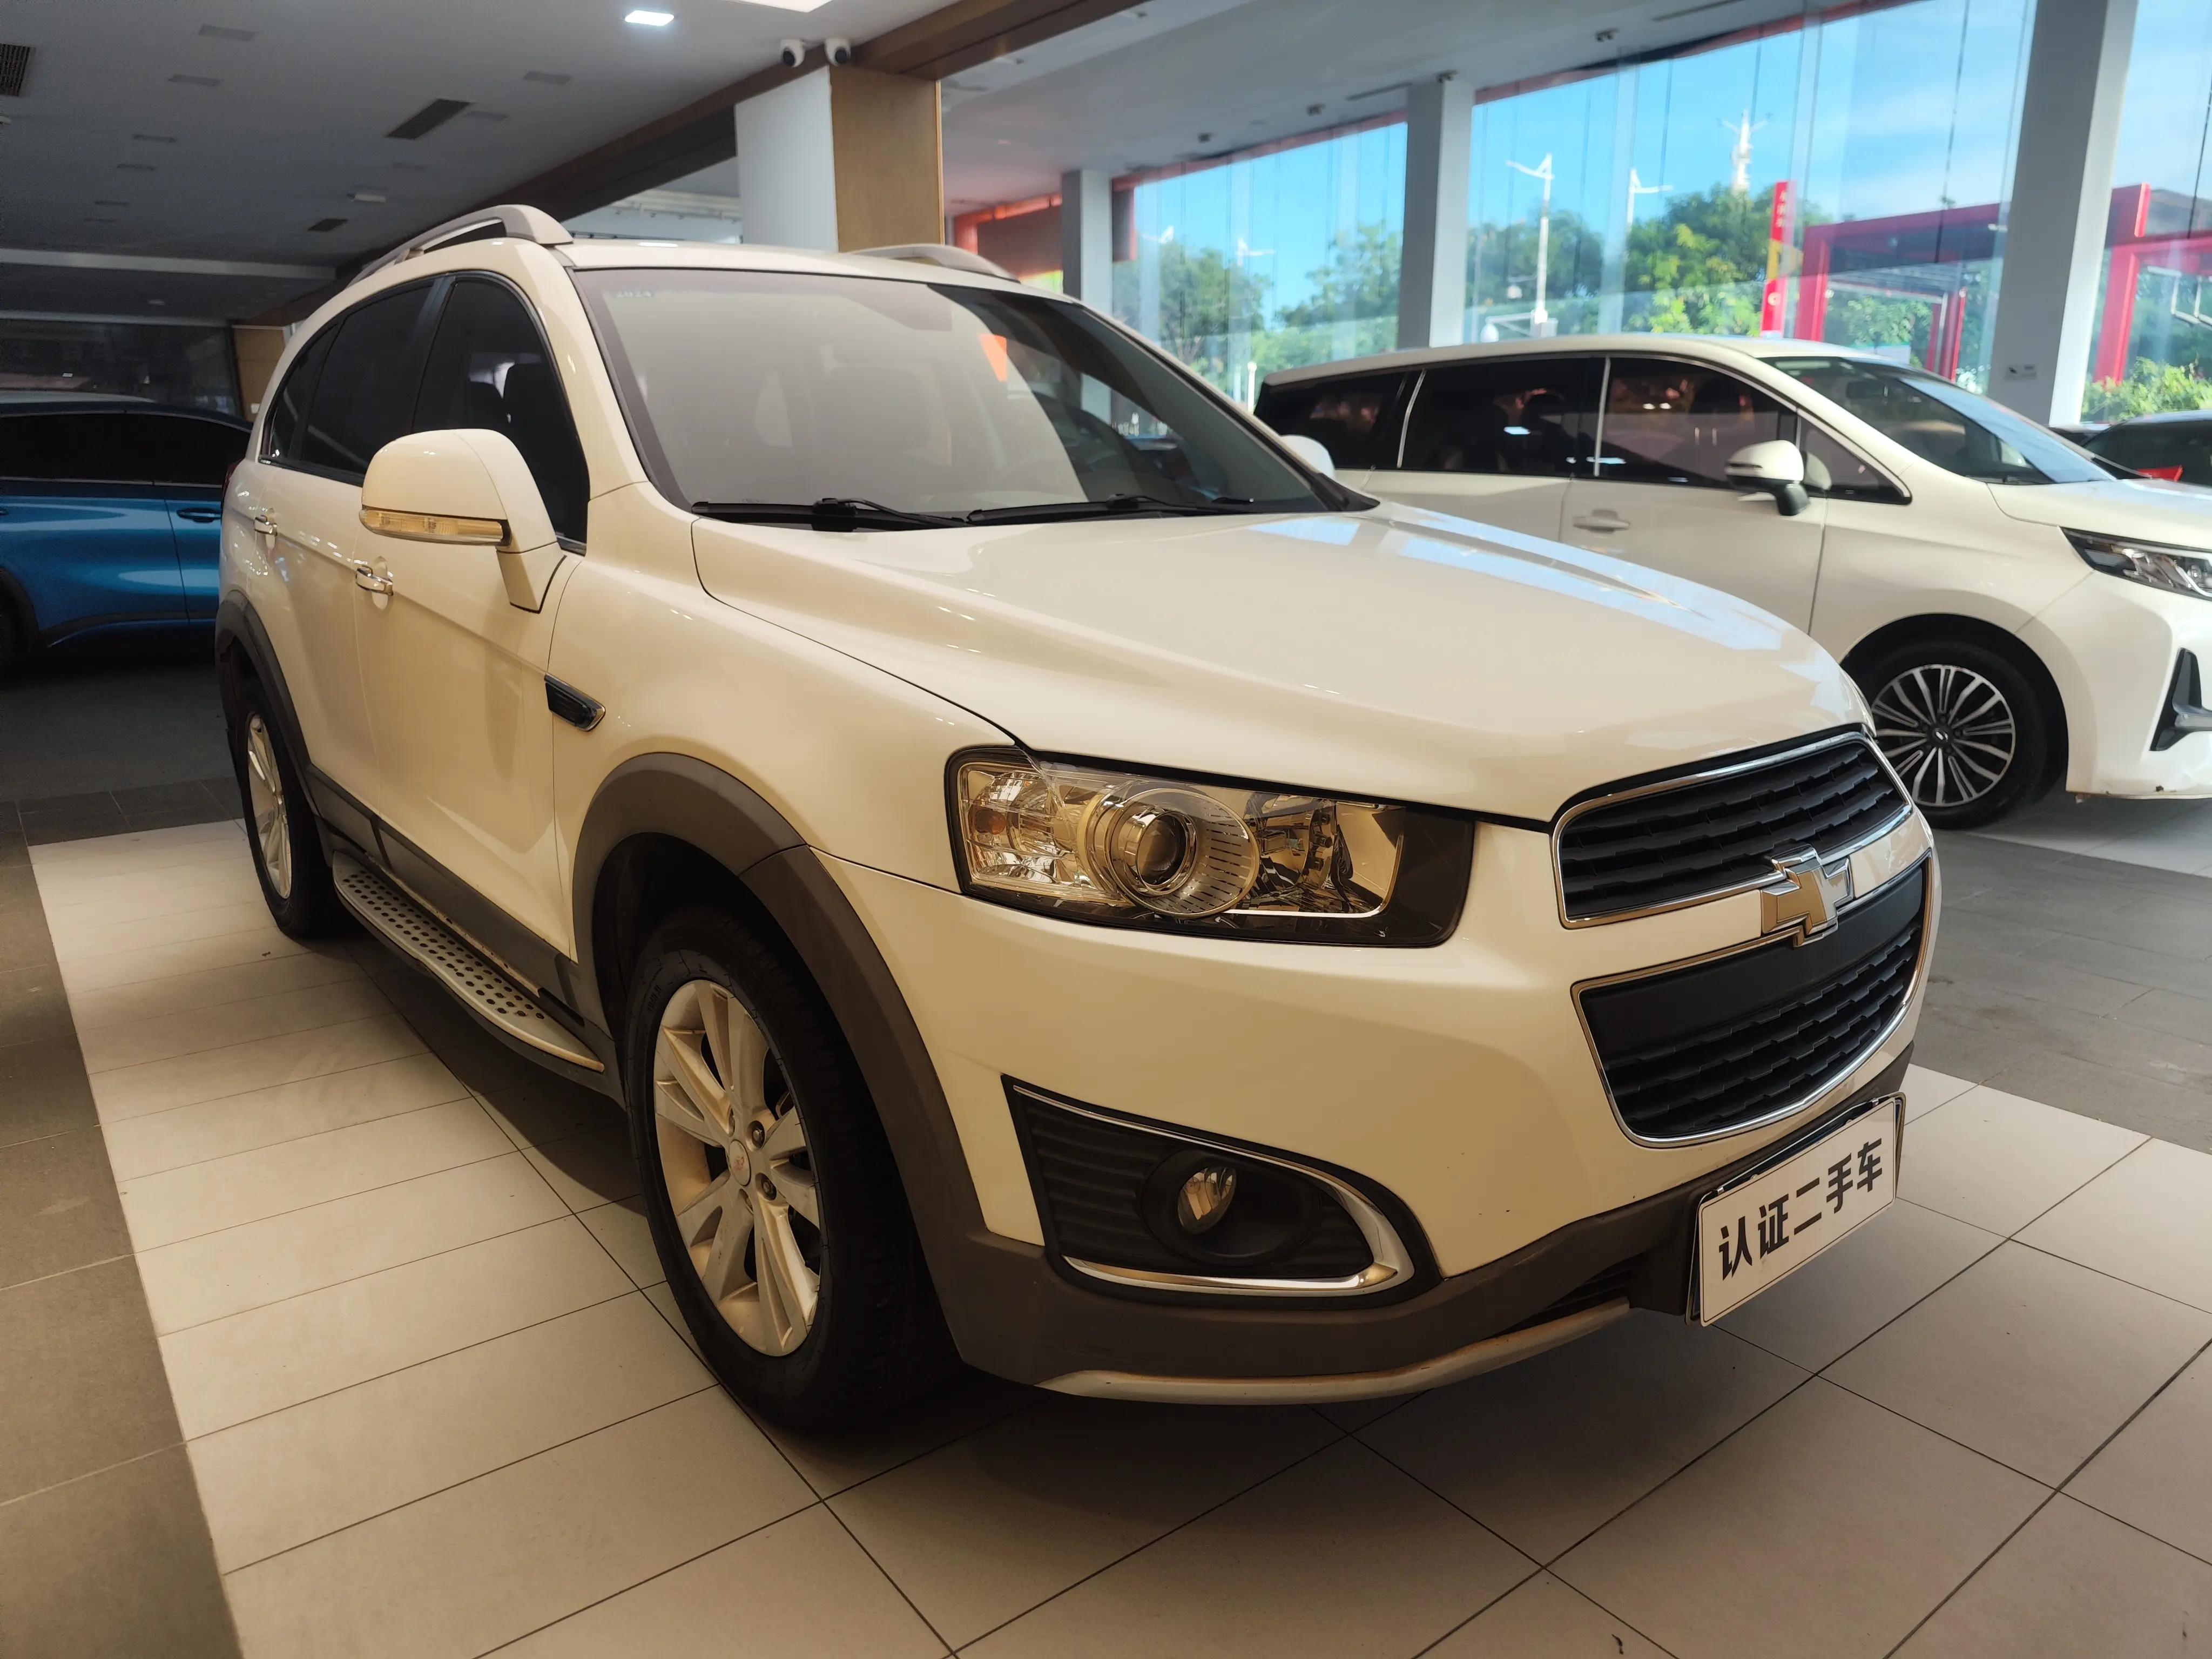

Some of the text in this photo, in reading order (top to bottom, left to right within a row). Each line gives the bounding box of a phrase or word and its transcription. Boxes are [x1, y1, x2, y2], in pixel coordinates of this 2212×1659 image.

[1719, 1138, 1883, 1281] 认证二手车
